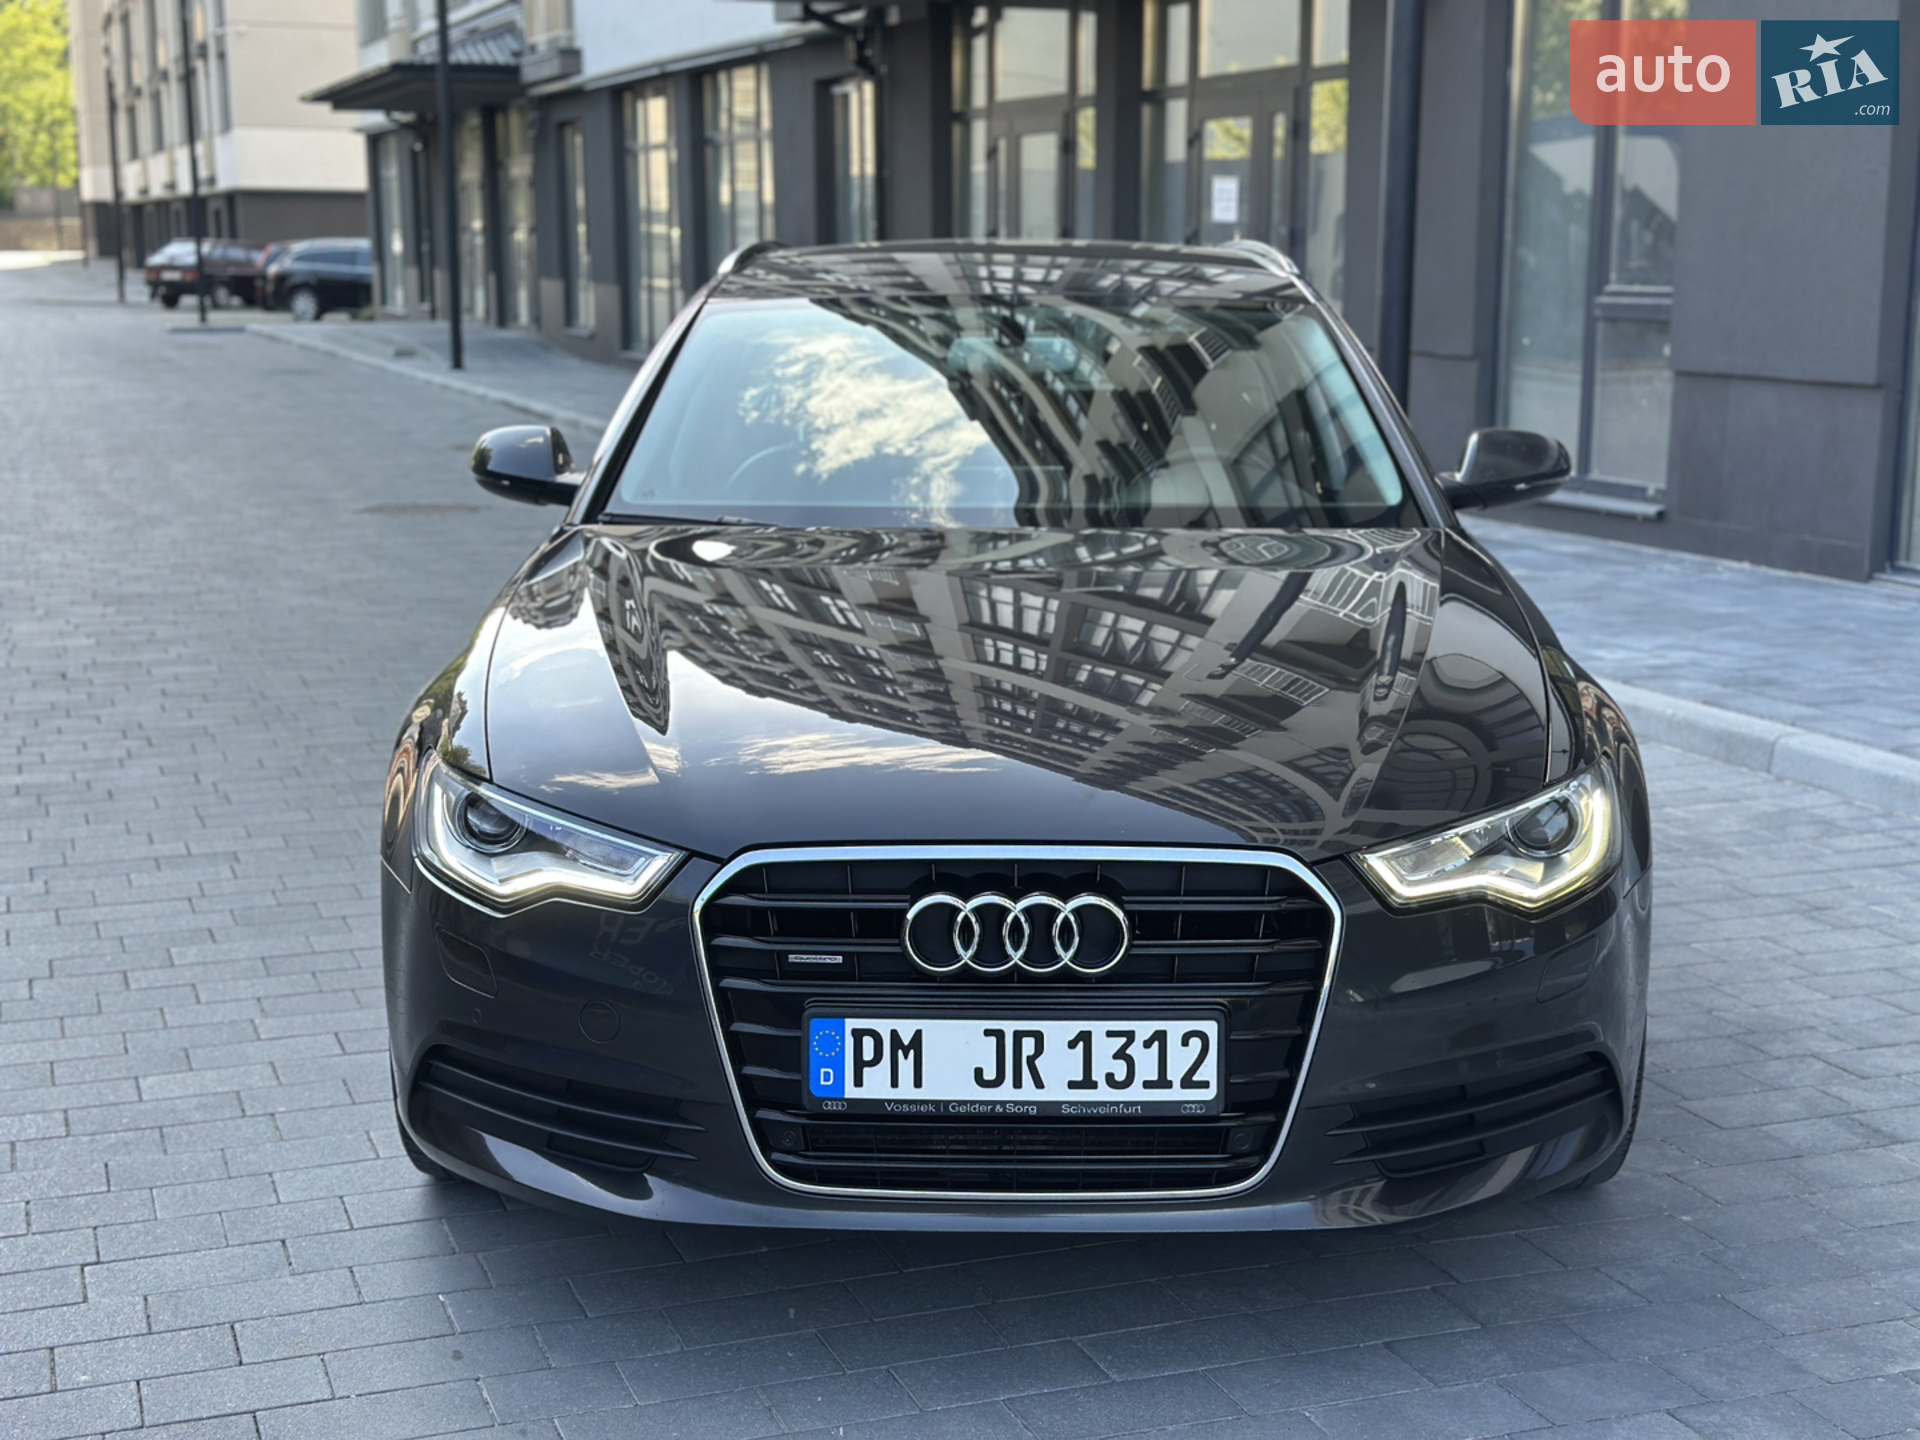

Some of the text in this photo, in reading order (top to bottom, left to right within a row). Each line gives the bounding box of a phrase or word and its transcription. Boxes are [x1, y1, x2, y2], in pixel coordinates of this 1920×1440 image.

[850, 1028, 1211, 1090] PM JR 1312
[820, 1067, 834, 1085] D
[884, 1101, 1143, 1116] Vossiek Gelder & Sorg Schweinfurt
